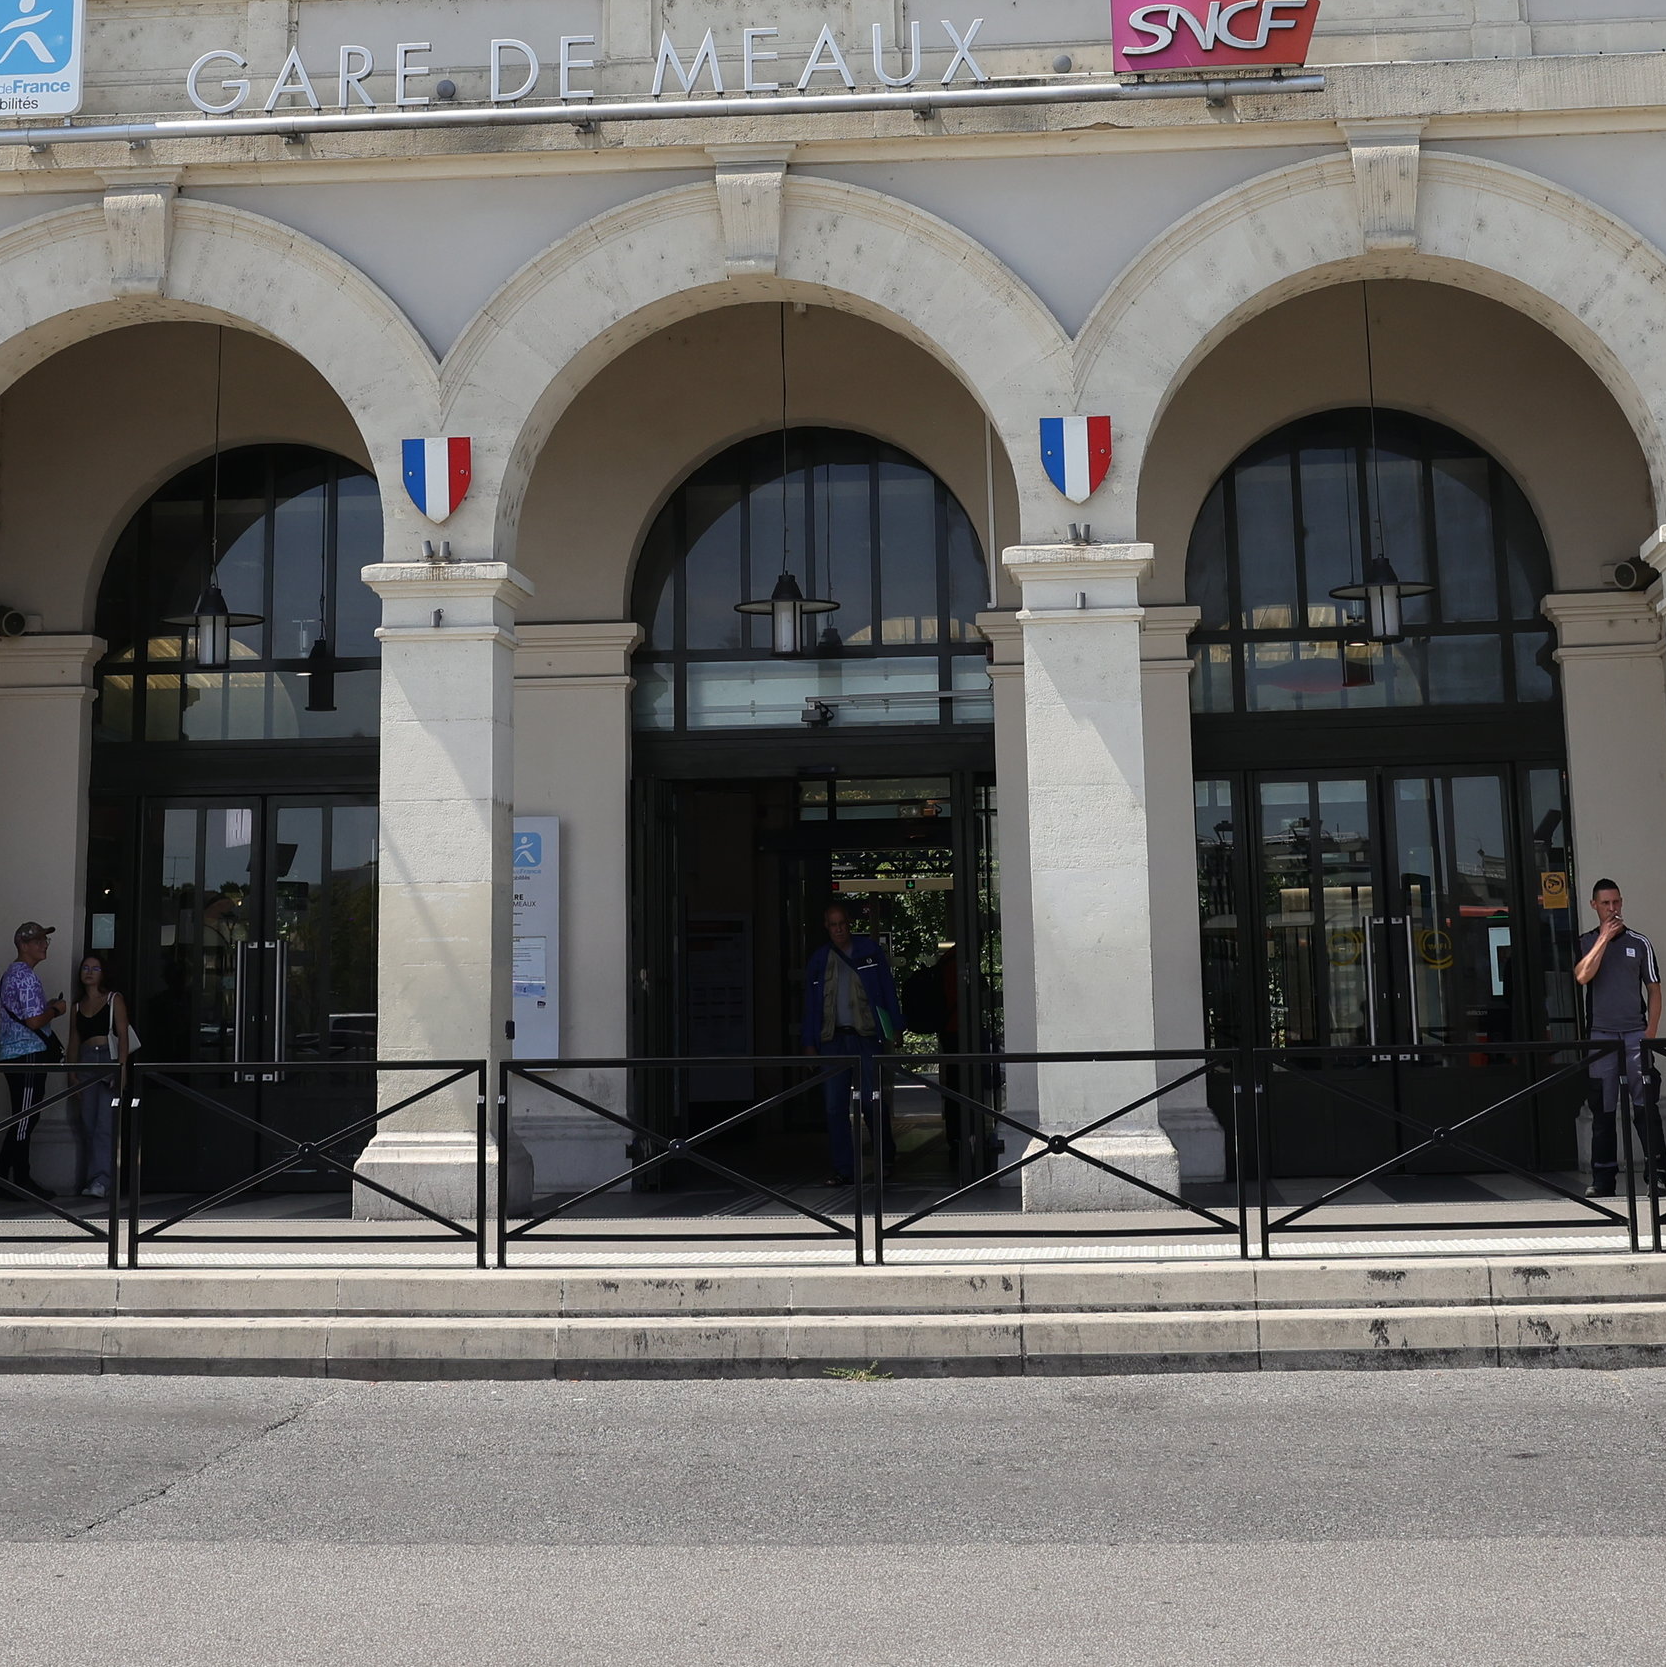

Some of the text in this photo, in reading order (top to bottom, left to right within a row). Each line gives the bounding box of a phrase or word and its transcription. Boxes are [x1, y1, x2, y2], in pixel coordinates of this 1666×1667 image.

[1122, 0, 1308, 55] SNCF
[186, 18, 988, 115] GARE DE MEAUX
